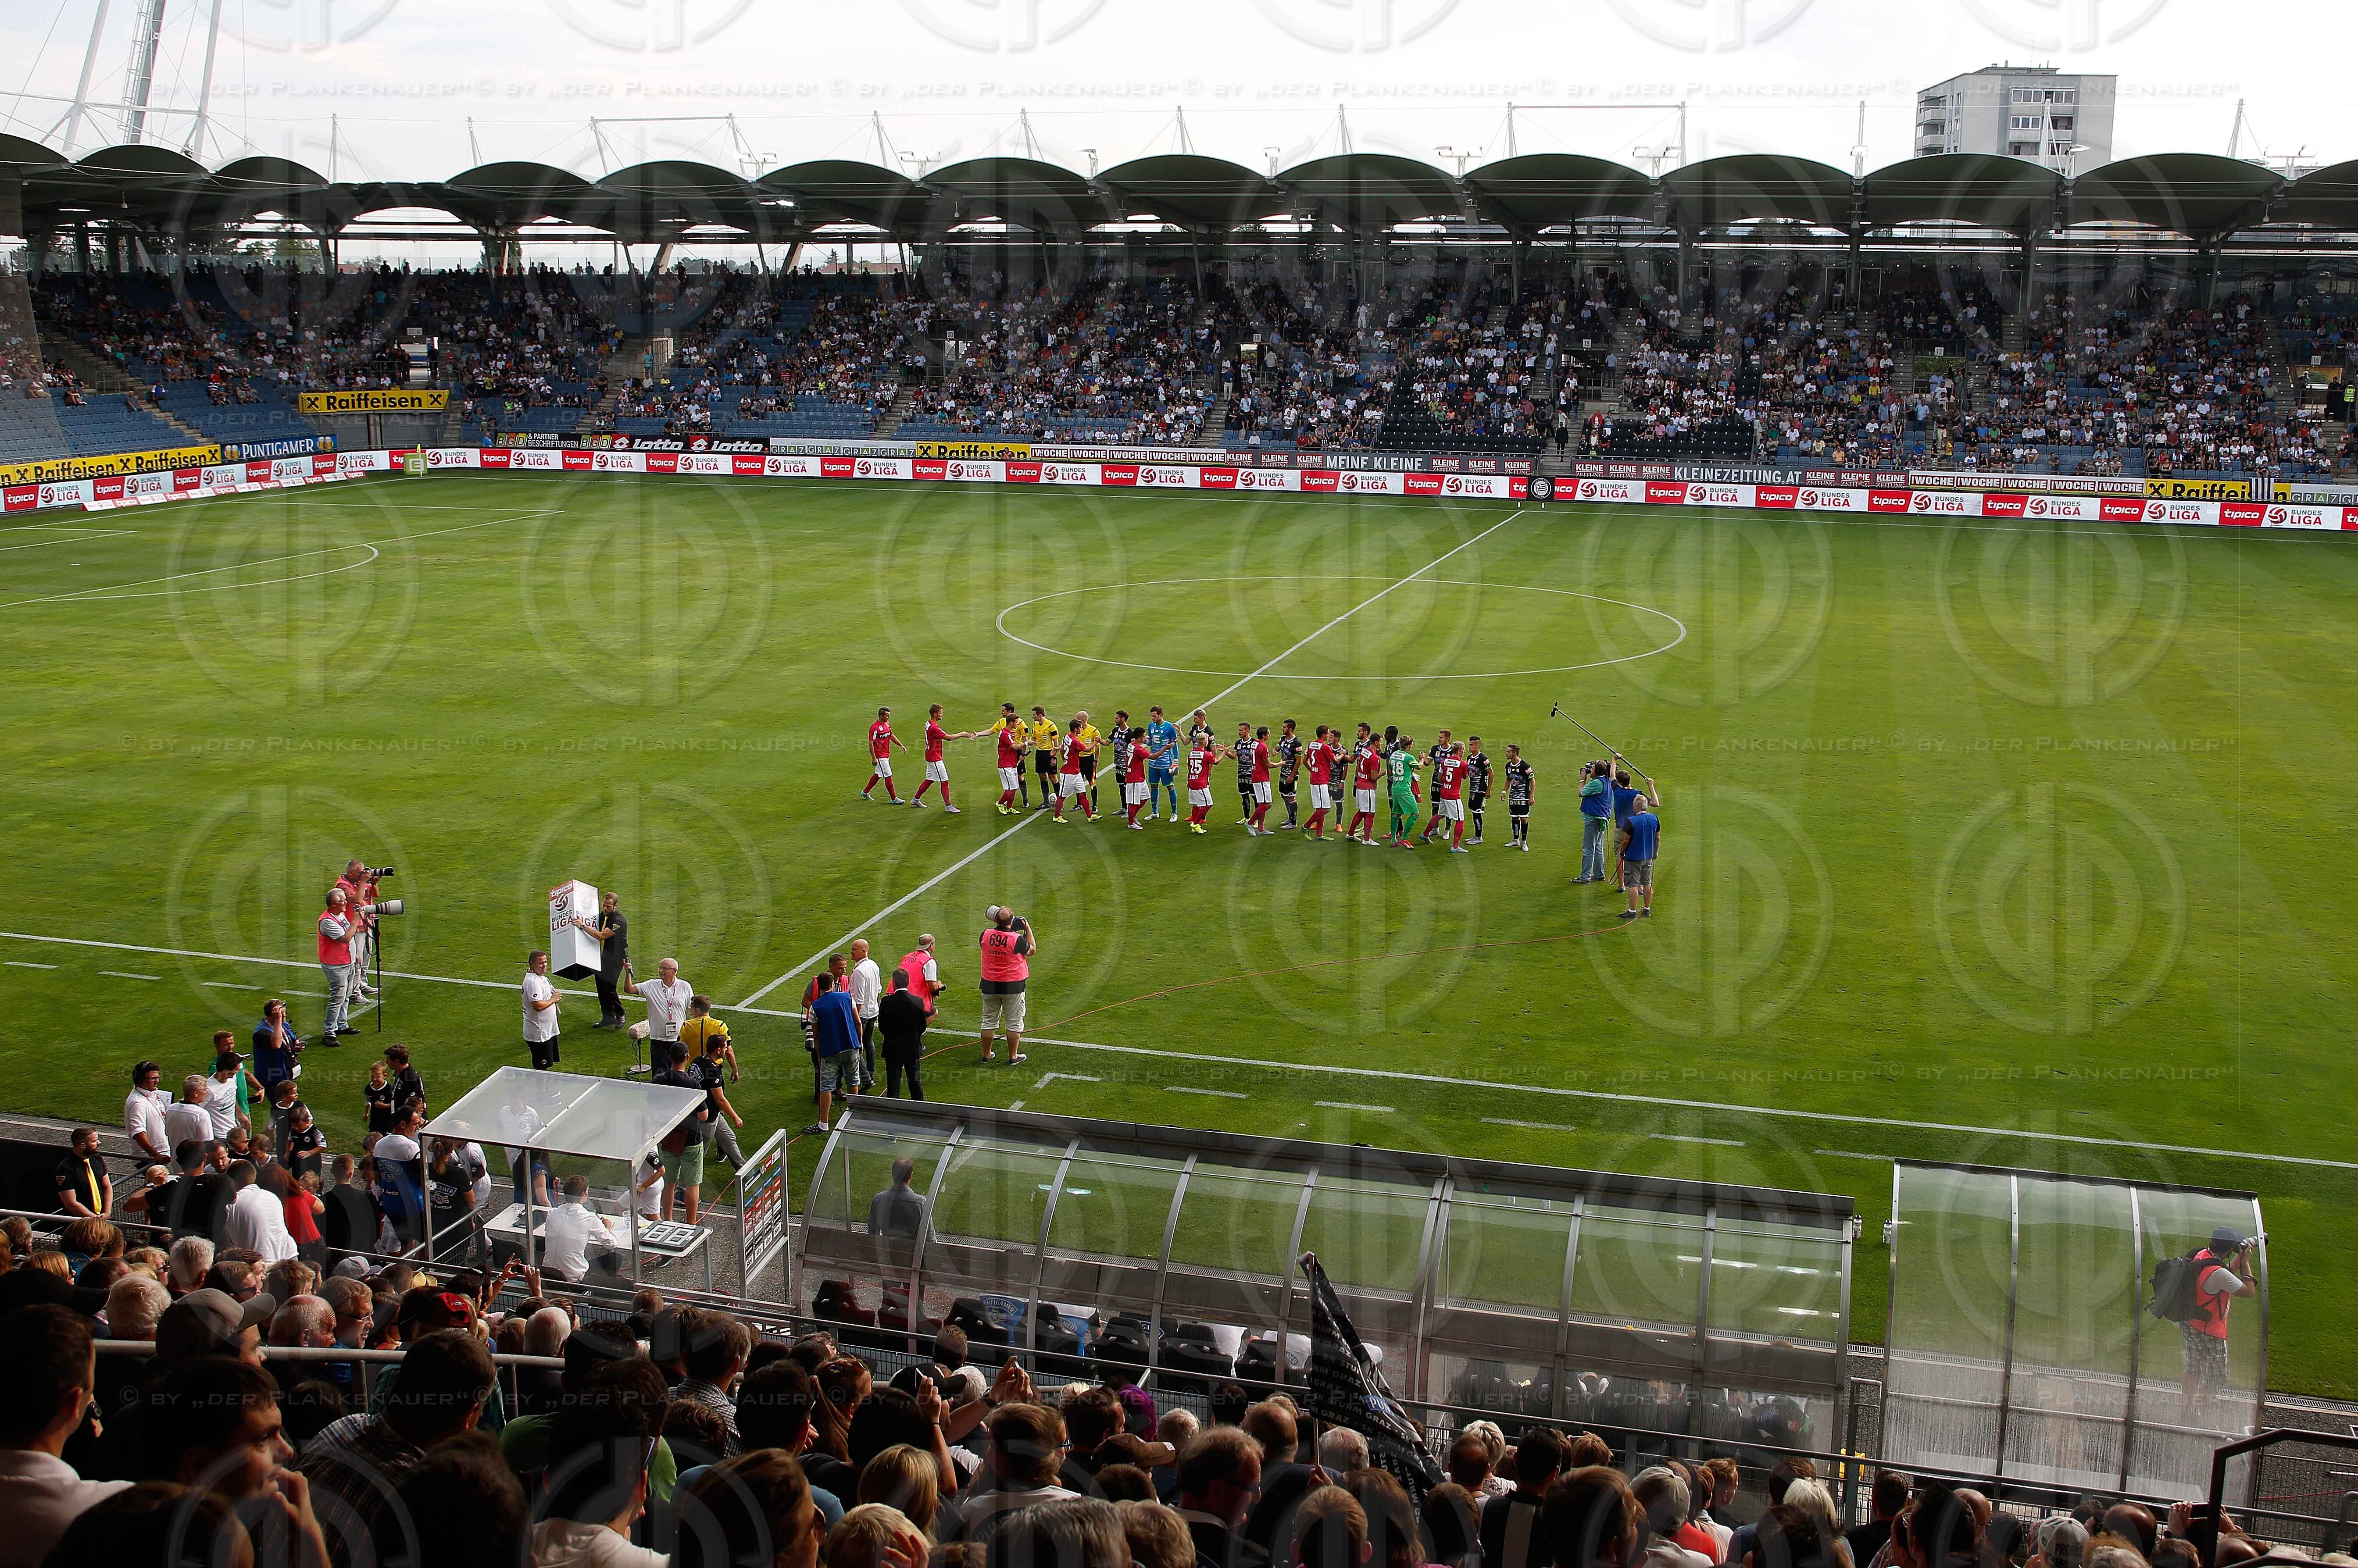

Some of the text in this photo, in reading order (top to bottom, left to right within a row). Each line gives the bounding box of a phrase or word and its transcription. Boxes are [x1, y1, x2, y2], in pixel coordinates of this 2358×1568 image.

[327, 393, 422, 410] Raiffeisen
[242, 439, 314, 459] PUNTIGAMER
[136, 450, 206, 472] Raiffeisen
[483, 454, 507, 463] tipico
[565, 455, 590, 465] tipico
[649, 458, 674, 467] tipico
[314, 460, 334, 469] tipico
[696, 463, 719, 471] LIGA
[735, 460, 761, 469] tipico
[784, 465, 807, 473] LIGA
[824, 462, 851, 471] tipico
[915, 464, 943, 474] tipico
[34, 461, 114, 482] Raiffeisen
[248, 467, 269, 478] tipico
[285, 467, 303, 475] LIGA
[874, 467, 898, 475] LIGA
[1009, 467, 1037, 477] tipico
[1105, 470, 1134, 480] tipico
[1674, 467, 1802, 484] KLEINEZEITUNG.AT
[176, 475, 198, 485] tipico
[216, 474, 235, 483] LIGA
[1061, 472, 1086, 481] LIGA
[1159, 475, 1185, 484] LIGA
[1204, 473, 1233, 482] tipico
[1304, 475, 1335, 485] tipico
[142, 482, 162, 492] LIGA
[1258, 478, 1285, 487] LIGA
[1361, 481, 1388, 490] LIGA
[1407, 479, 1439, 489] tipico
[96, 485, 121, 495] tipico
[1465, 485, 1493, 493] LIGA
[1600, 490, 1628, 498] LIGA
[1649, 487, 1682, 498] tipico
[2172, 483, 2288, 501] Raiffein
[7, 494, 34, 504] tipico
[57, 492, 81, 501] LIGA
[1710, 493, 1738, 502] LIGA
[1759, 491, 1793, 502] tipico
[1872, 495, 1906, 506] tipico
[1821, 498, 1850, 507] LIGA
[1935, 502, 1964, 511] LIGA
[1986, 499, 2021, 510] tipico
[2051, 507, 2081, 516] LIGA
[2104, 504, 2139, 515] tipico
[2224, 508, 2260, 520] tipico
[2169, 511, 2201, 520] LIGA
[2290, 516, 2322, 525] LIGA
[1446, 767, 1453, 782] 5
[551, 884, 572, 897] tipico
[552, 910, 572, 923] BUNDES
[552, 917, 573, 931] LIGA
[989, 934, 1008, 948] 694
[1365, 1411, 1393, 1429] GRAZ
